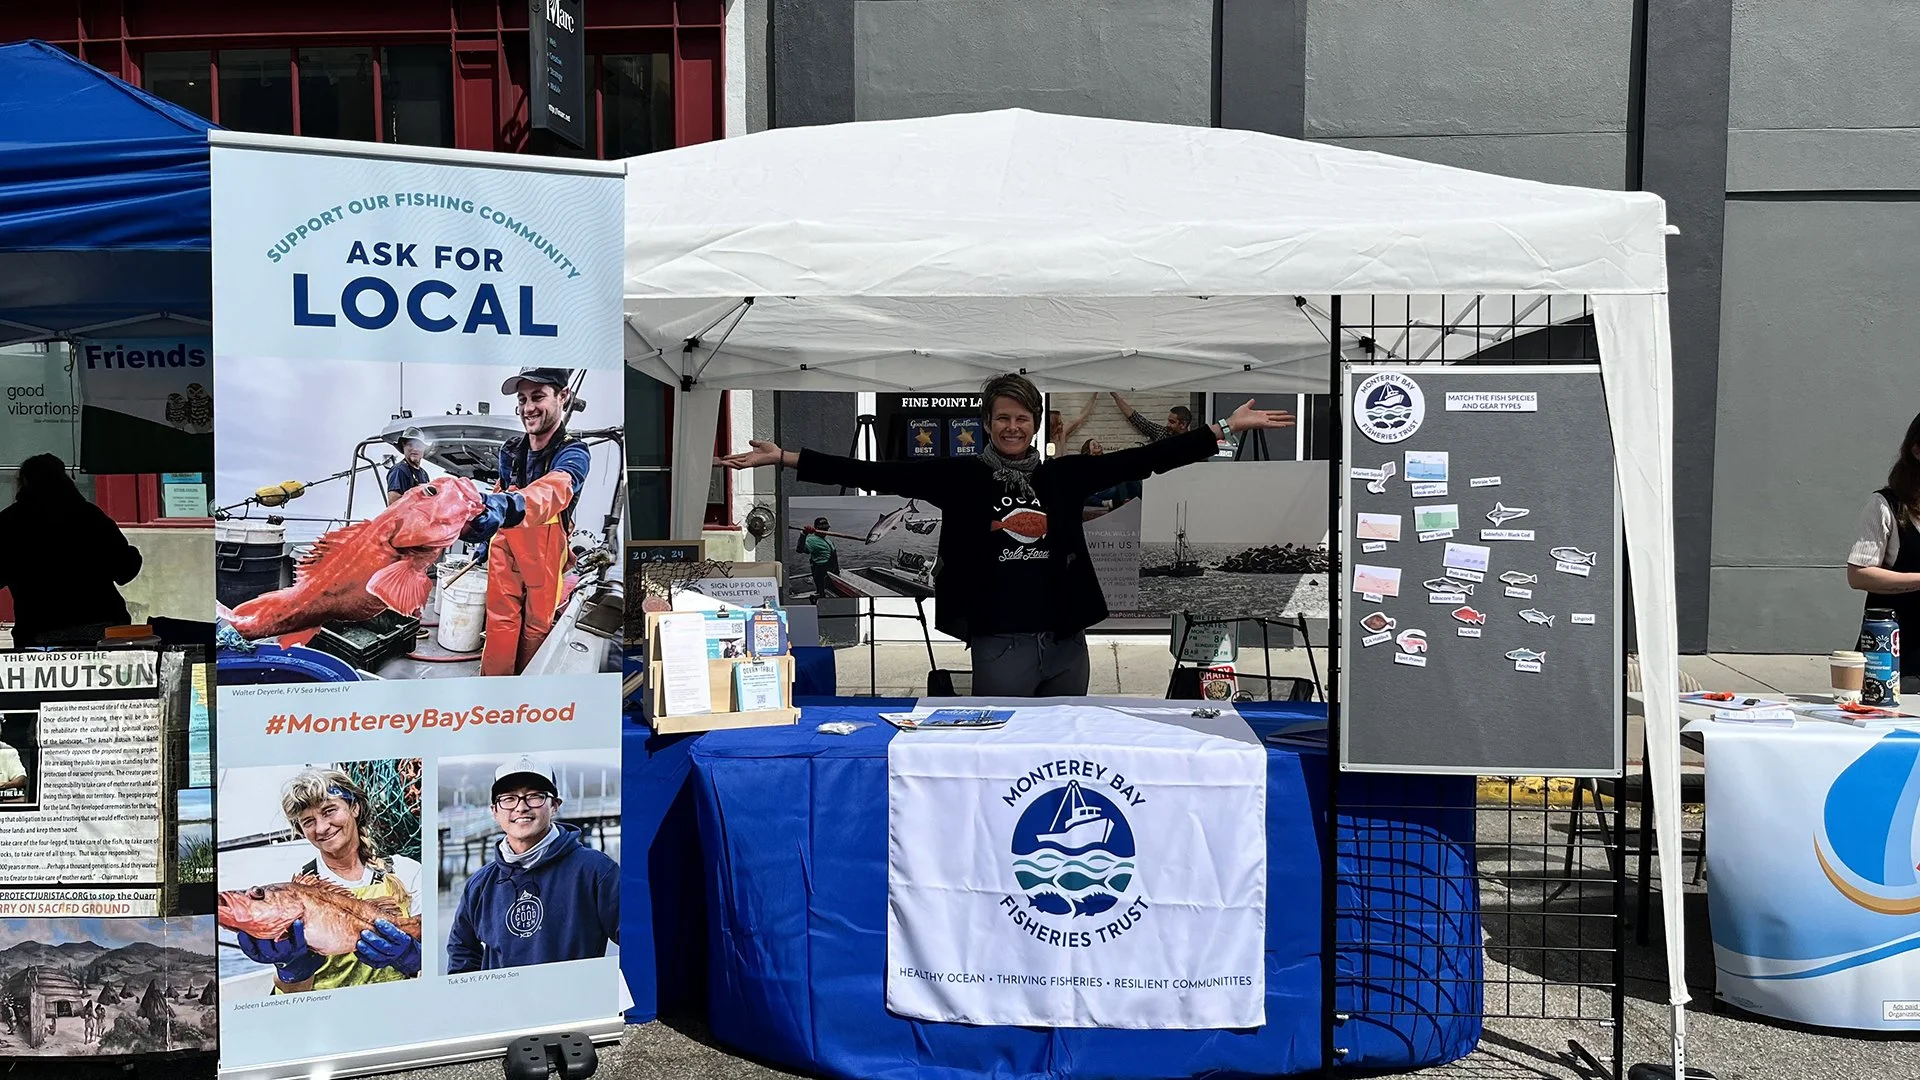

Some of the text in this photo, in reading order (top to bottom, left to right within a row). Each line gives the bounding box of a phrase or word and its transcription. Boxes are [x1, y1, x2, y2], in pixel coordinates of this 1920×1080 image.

[266, 192, 581, 280] SUPPORT OUR FISHING COMMUNITY
[346, 240, 503, 272] ASK FOR
[293, 273, 558, 337] LOCAL
[85, 344, 206, 369] Friends
[1360, 375, 1415, 393] MONTEREY BAY
[7, 384, 44, 400] good
[8, 402, 79, 415] vibrations
[902, 398, 929, 407] FINE
[932, 398, 967, 407] POINT
[1362, 420, 1418, 440] FISHERIES TRUST
[1088, 541, 1131, 549] WITH US
[633, 552, 646, 560] 20
[1214, 635, 1219, 643] 8
[27, 653, 67, 661] WORDS
[70, 652, 82, 660] OF
[86, 652, 107, 660] THE
[1214, 649, 1219, 657] 8
[35, 664, 153, 689] MUTSUN
[265, 702, 575, 735] #MontereyBaySeafood
[1002, 760, 1146, 808] MONTEREY BAY
[99, 892, 115, 901] stop
[118, 892, 133, 900] the
[20, 904, 35, 913] ON
[38, 903, 79, 913] SACRED
[82, 903, 130, 914] GROUND
[517, 905, 535, 913] REAL
[515, 911, 536, 922] GOOD
[999, 895, 1149, 947] FISHERIES TRUST
[517, 919, 535, 928] FISH
[900, 968, 1252, 989] HEALTHY OCEAN THRIVING FISHERIES RESILIENT COMMUNITITES
[261, 999, 290, 1007] Lambert,
